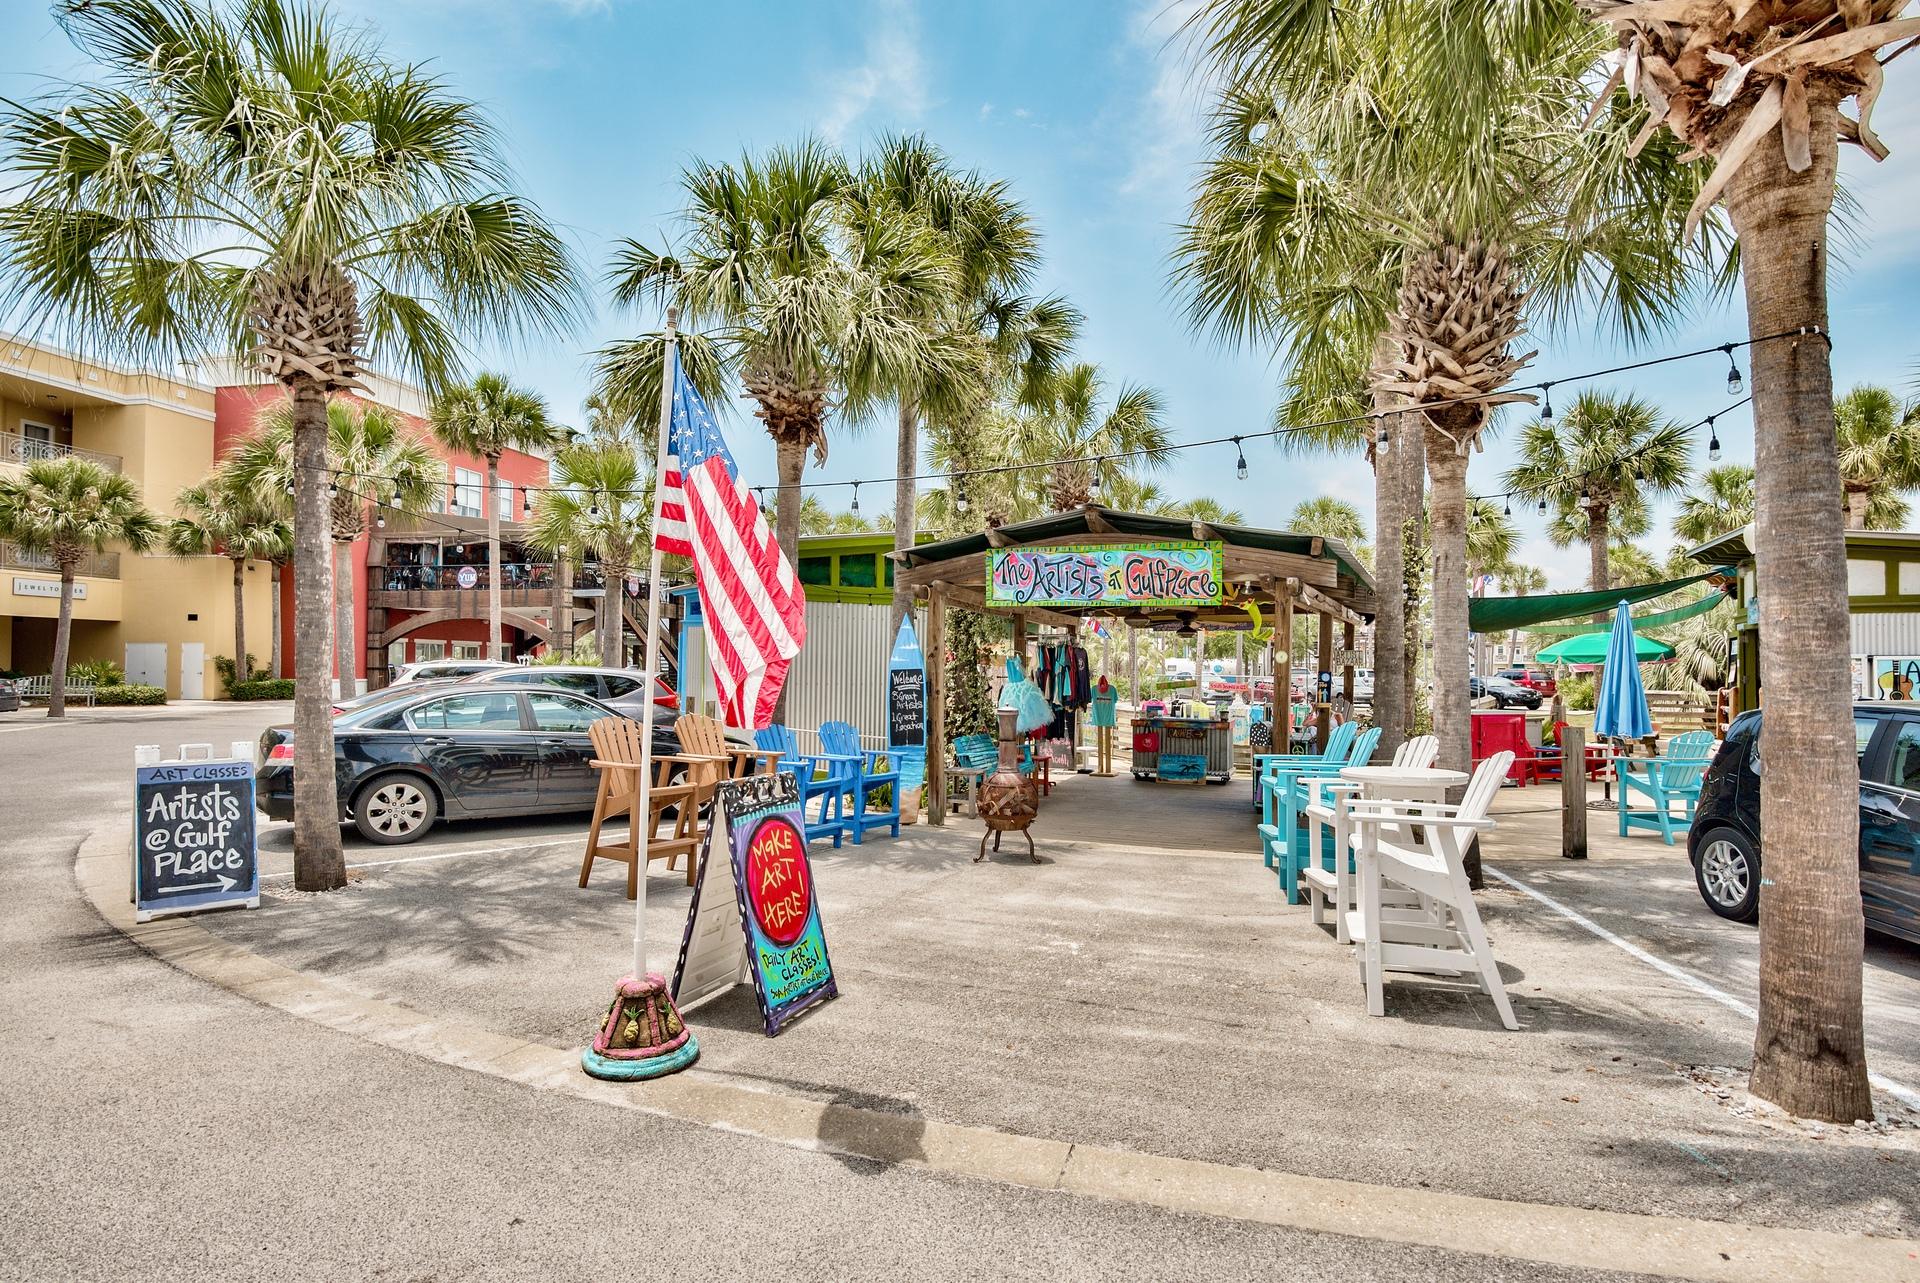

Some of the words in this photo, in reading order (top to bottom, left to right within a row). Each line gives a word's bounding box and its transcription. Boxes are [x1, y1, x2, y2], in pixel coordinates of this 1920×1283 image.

[995, 553, 1031, 586] The
[459, 572, 477, 582] YUM
[18, 582, 46, 592] JEWEL
[49, 586, 84, 594] TOER
[892, 671, 925, 686] Welcome
[898, 691, 918, 702] Great
[896, 700, 923, 710] Artists
[896, 711, 919, 723] Great
[895, 721, 924, 732] Location
[150, 768, 188, 781] ART
[146, 783, 241, 823] Artists
[145, 829, 171, 851] @
[174, 821, 232, 849] Gulf
[762, 858, 795, 896] ART
[791, 940, 809, 965] ART
